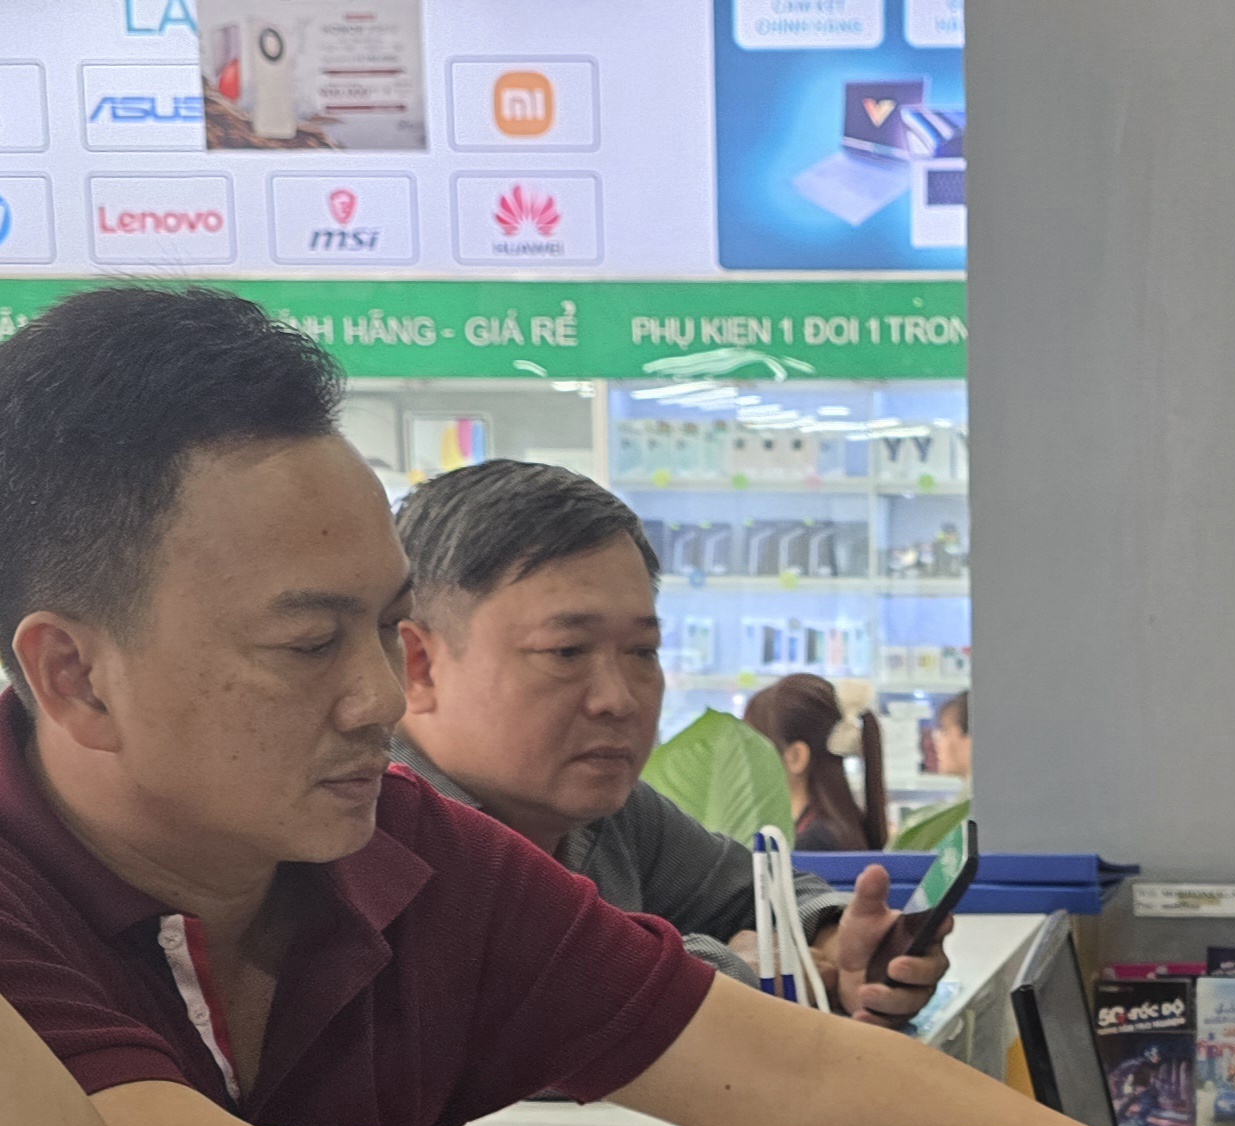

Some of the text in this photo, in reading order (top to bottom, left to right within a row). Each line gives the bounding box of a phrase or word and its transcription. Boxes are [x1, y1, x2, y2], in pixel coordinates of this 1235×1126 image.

[126, 0, 199, 37] LA
[98, 206, 225, 235] Lenovo
[309, 227, 381, 252] msi
[631, 315, 695, 350] PHỤ
[778, 316, 793, 345] 1
[865, 316, 880, 345] 1
